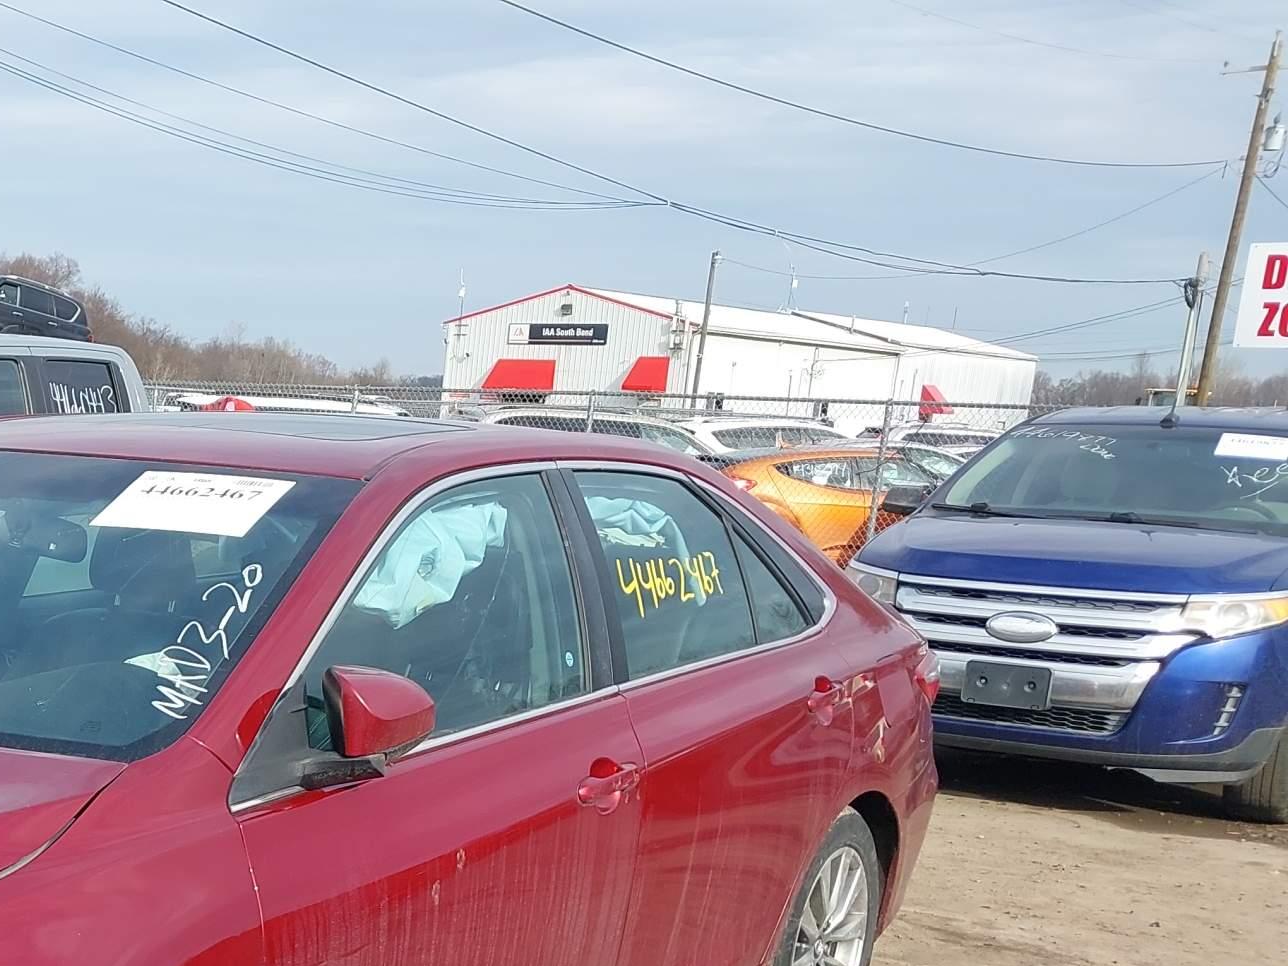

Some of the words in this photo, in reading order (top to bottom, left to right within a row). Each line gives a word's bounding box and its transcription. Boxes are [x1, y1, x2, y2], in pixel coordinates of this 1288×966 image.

[542, 327, 555, 337] IAA
[555, 327, 575, 337] South
[576, 327, 594, 337] Bend
[140, 484, 264, 501] 44662467
[615, 550, 724, 619] 44662467
[176, 563, 263, 661] 3-20
